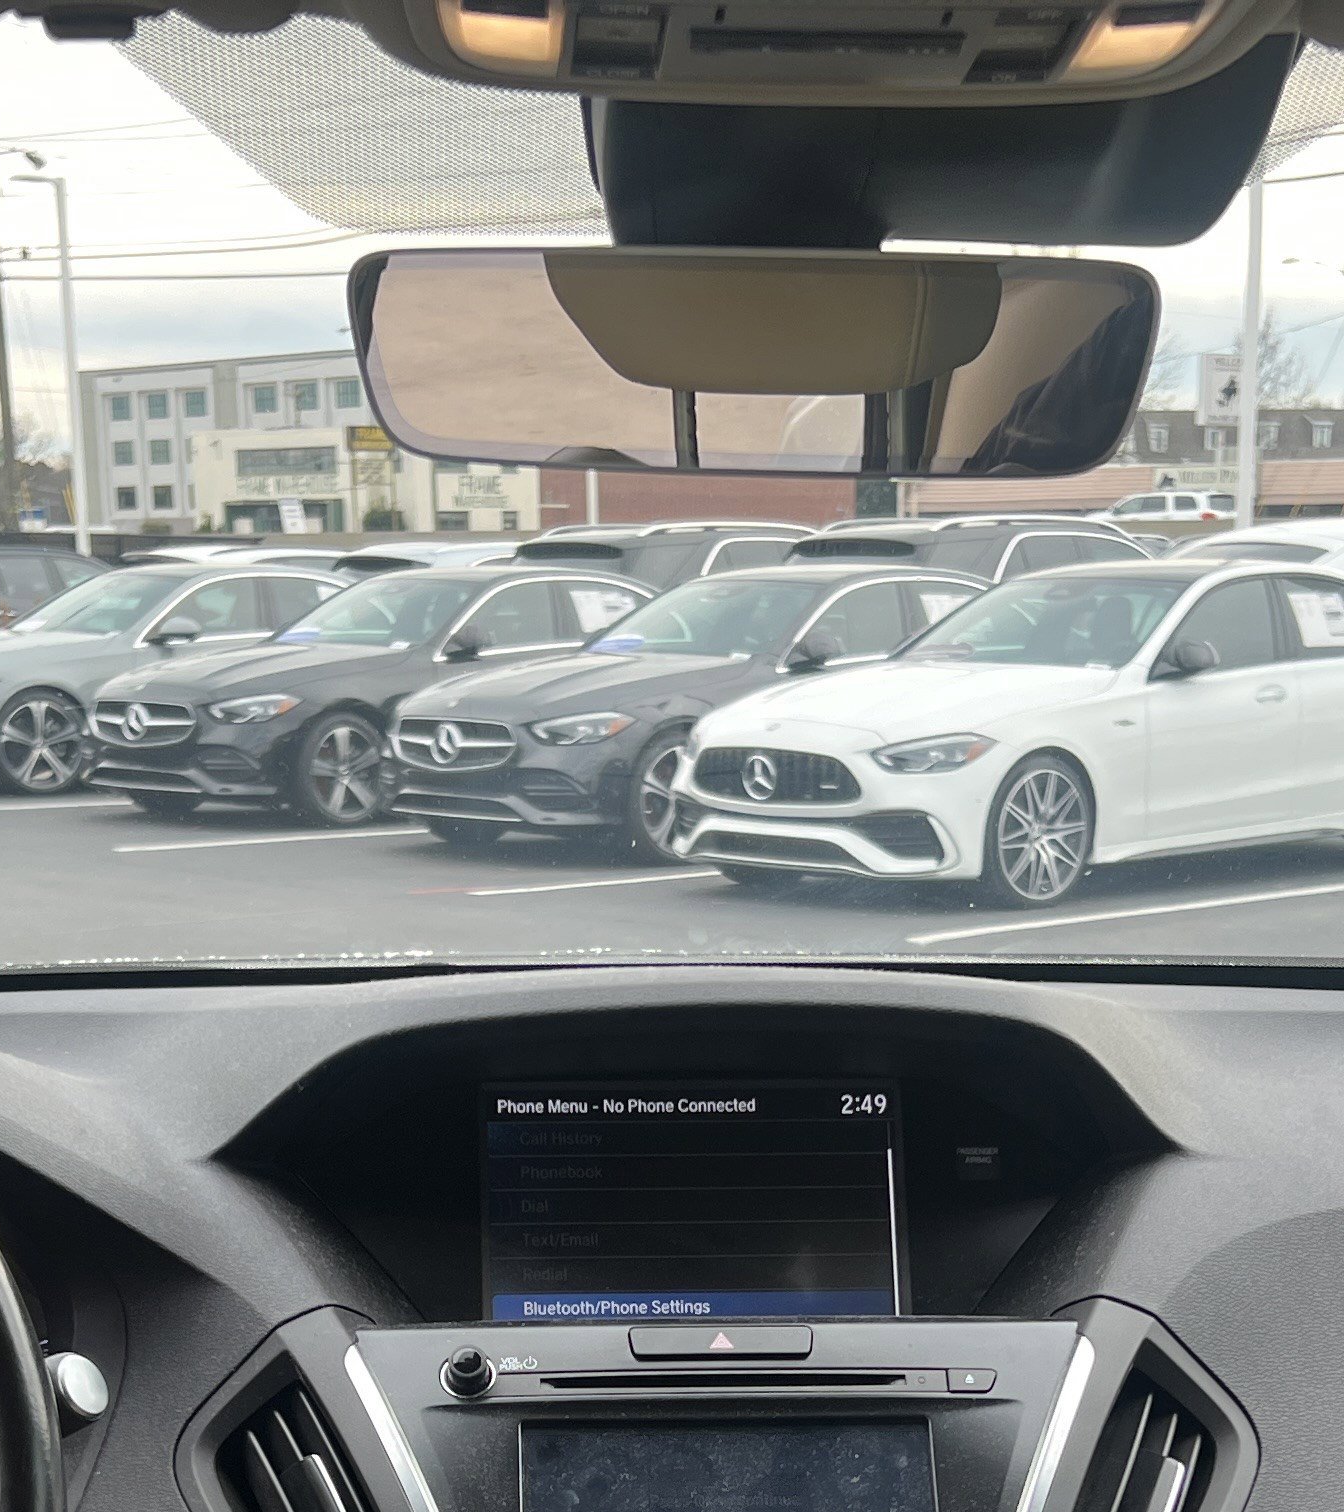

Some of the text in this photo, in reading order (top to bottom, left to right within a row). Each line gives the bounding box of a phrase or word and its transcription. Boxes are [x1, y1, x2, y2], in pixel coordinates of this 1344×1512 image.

[497, 1099, 544, 1115] Phone
[548, 1099, 588, 1114] Menu
[603, 1099, 625, 1114] No
[628, 1098, 674, 1114] Phone
[678, 1097, 756, 1113] Connected
[841, 1093, 887, 1115] 2:49
[523, 1299, 711, 1317] Bluetooth/Phone Settings
